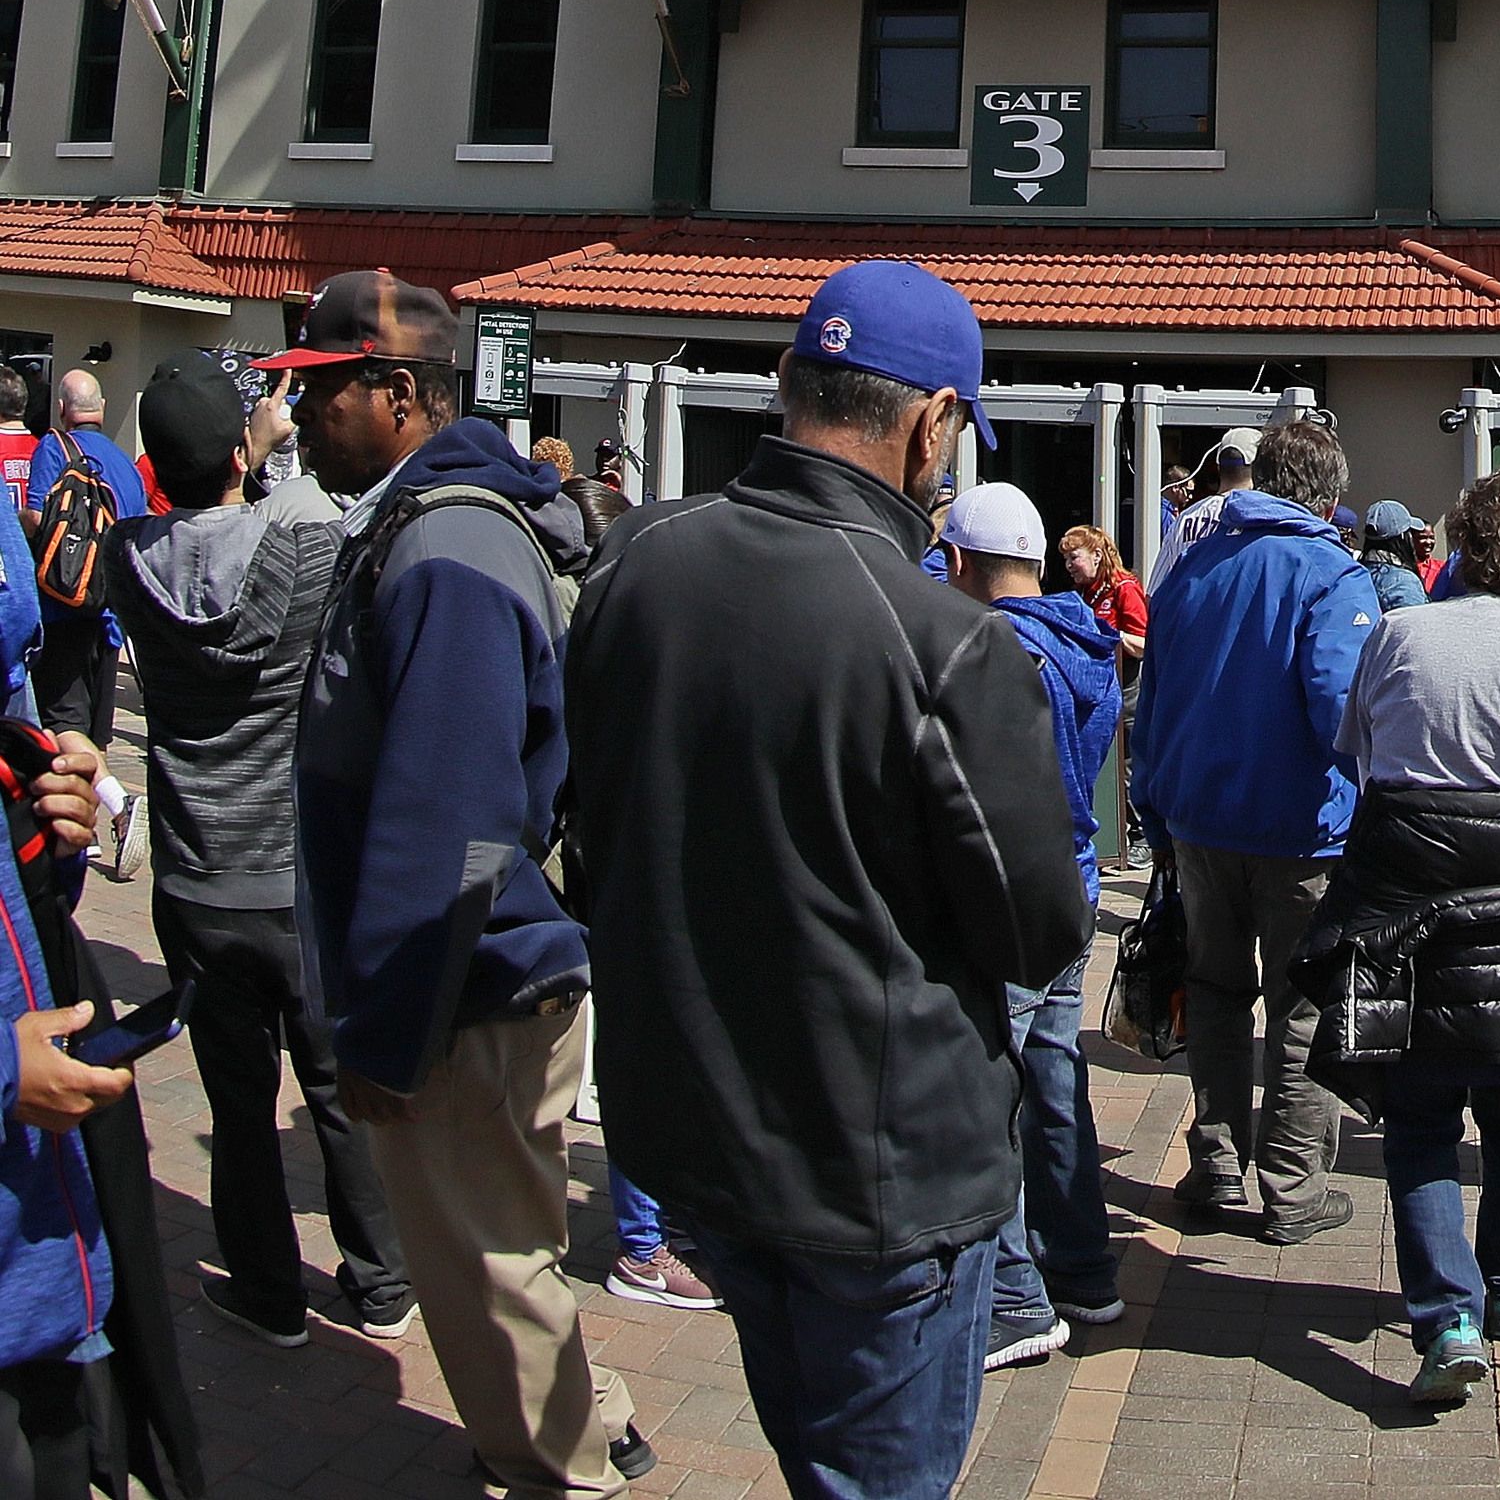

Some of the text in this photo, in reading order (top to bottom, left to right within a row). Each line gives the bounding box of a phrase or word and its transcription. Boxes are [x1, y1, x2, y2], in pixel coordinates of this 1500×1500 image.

[983, 91, 1081, 112] GATE
[993, 114, 1066, 180] 3
[499, 322, 529, 330] DETECTORS
